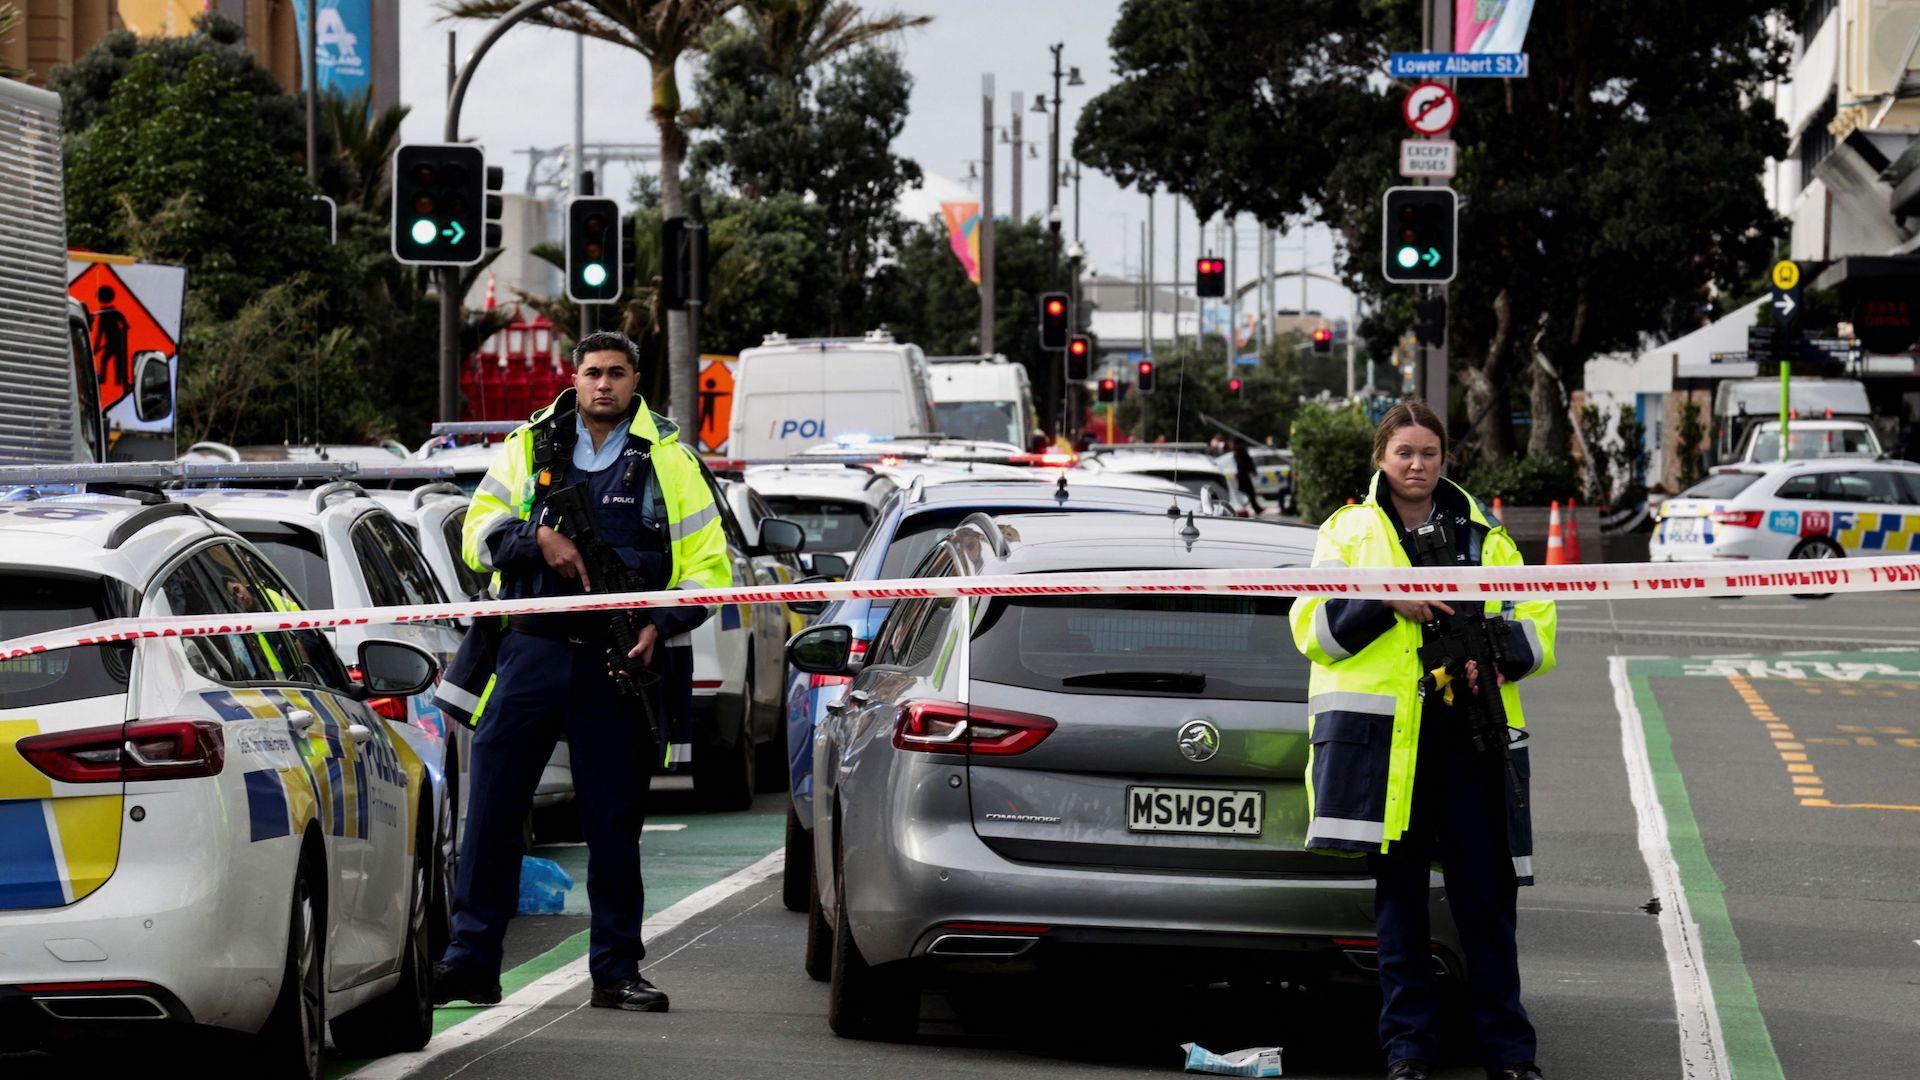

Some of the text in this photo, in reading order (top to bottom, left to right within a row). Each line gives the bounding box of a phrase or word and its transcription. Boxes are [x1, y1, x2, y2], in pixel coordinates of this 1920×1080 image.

[1397, 56, 1513, 73] Lower Albert St
[1407, 146, 1449, 156] EXCEPT
[1409, 161, 1446, 170] BUSES
[612, 496, 636, 504] POLICE
[1775, 516, 1796, 528] 105
[1806, 515, 1826, 530] 111
[1669, 532, 1698, 544] POLICE
[1132, 792, 1256, 829] MSW964
[985, 813, 1062, 825] COMMODORE
